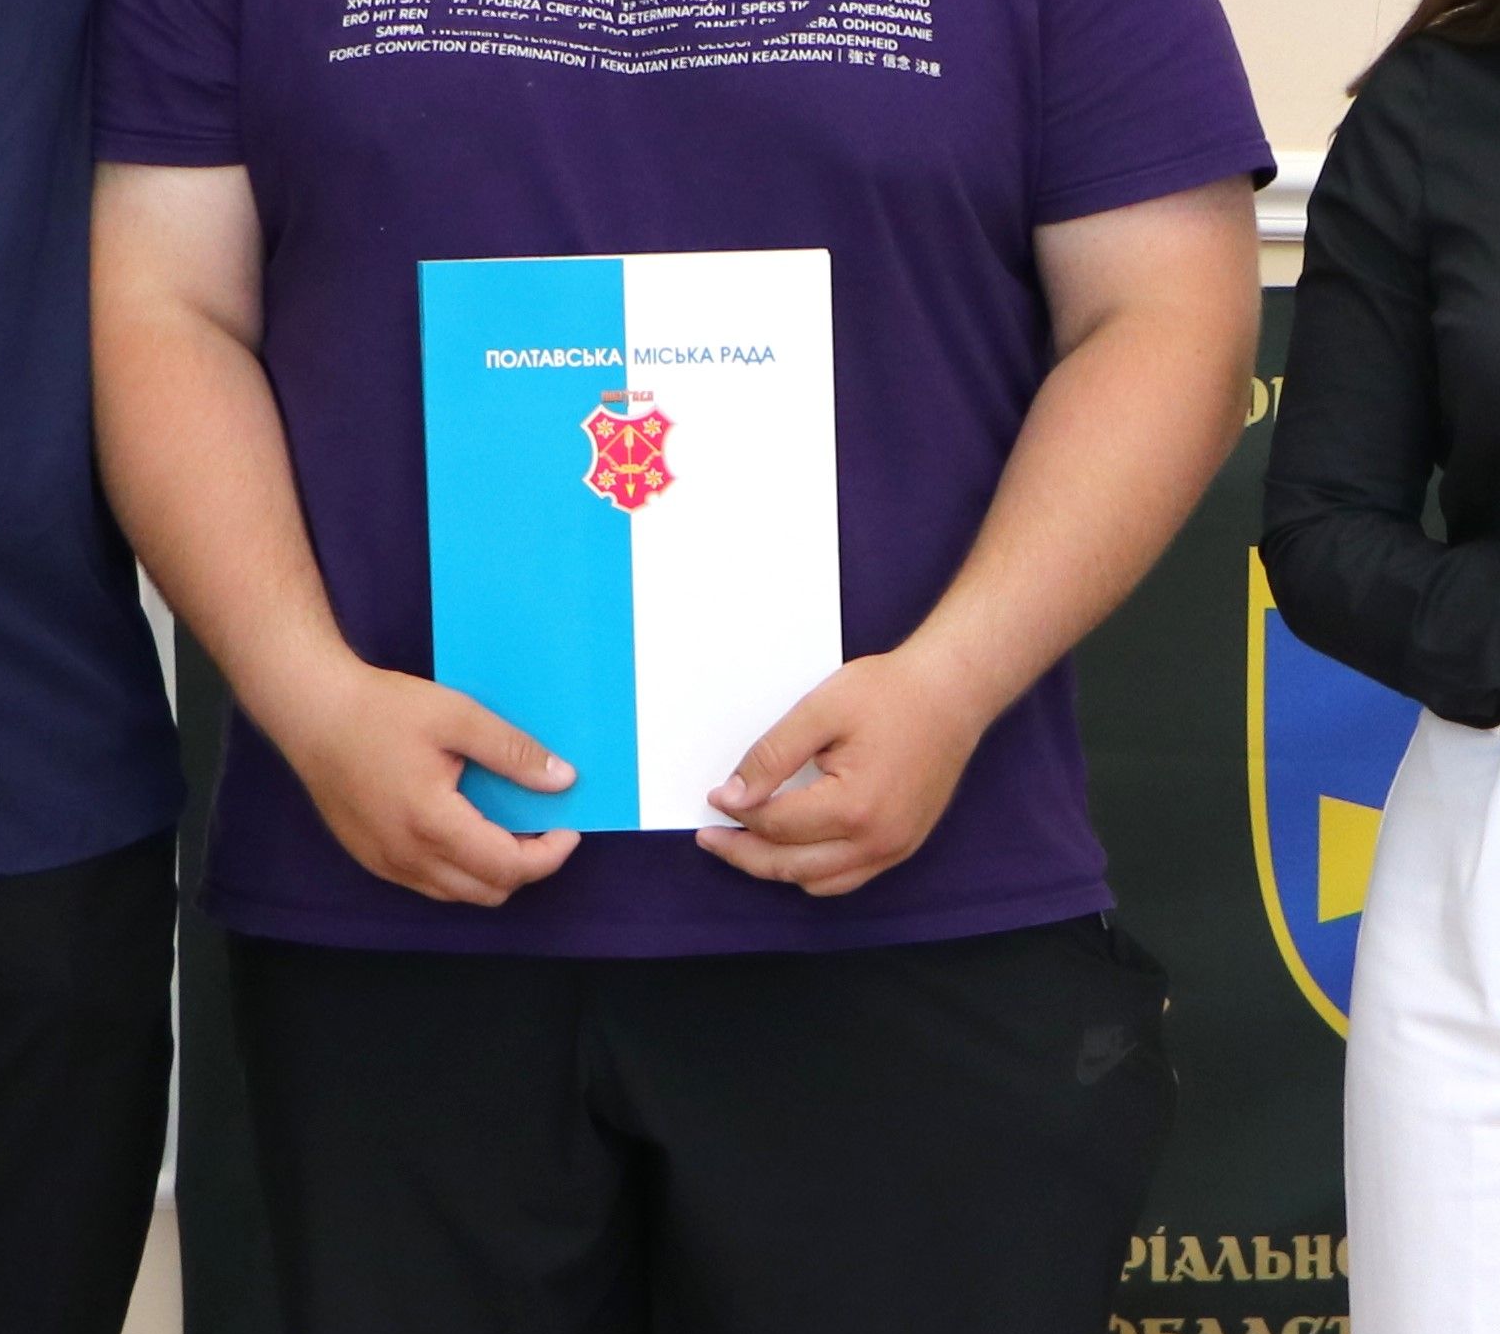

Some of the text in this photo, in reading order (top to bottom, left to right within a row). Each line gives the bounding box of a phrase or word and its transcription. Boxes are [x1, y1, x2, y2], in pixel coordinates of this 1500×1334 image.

[372, 9, 396, 21] HIT
[842, 17, 933, 42] ODHODLANIE
[328, 40, 586, 68] FORCE CONVICTION DÉTERMINATION
[600, 49, 832, 74] KEKUATAN KEYAKINAN KEAZAMAN
[485, 346, 775, 369] ПОЛТАВСЬКА МІСЬКА РАДА
